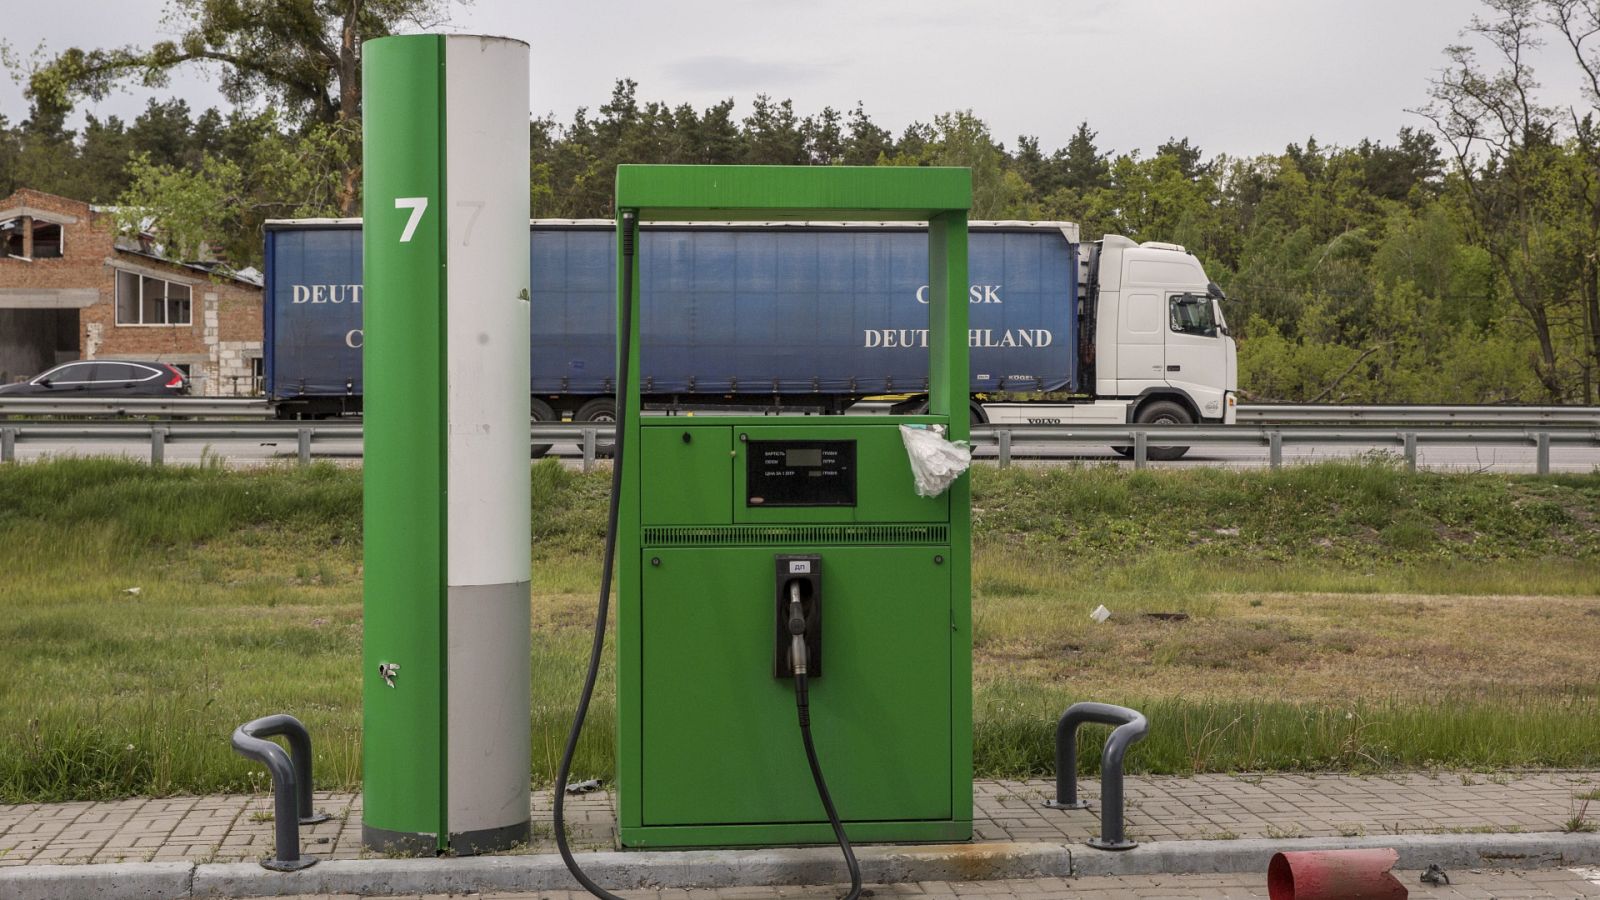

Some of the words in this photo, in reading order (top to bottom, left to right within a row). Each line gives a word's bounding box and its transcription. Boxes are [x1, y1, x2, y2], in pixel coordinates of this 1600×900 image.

[394, 197, 428, 243] 7
[456, 200, 485, 247] 7
[291, 284, 364, 304] DEUT
[916, 285, 1003, 304] CSK
[863, 329, 1053, 348] DEUTHLAND
